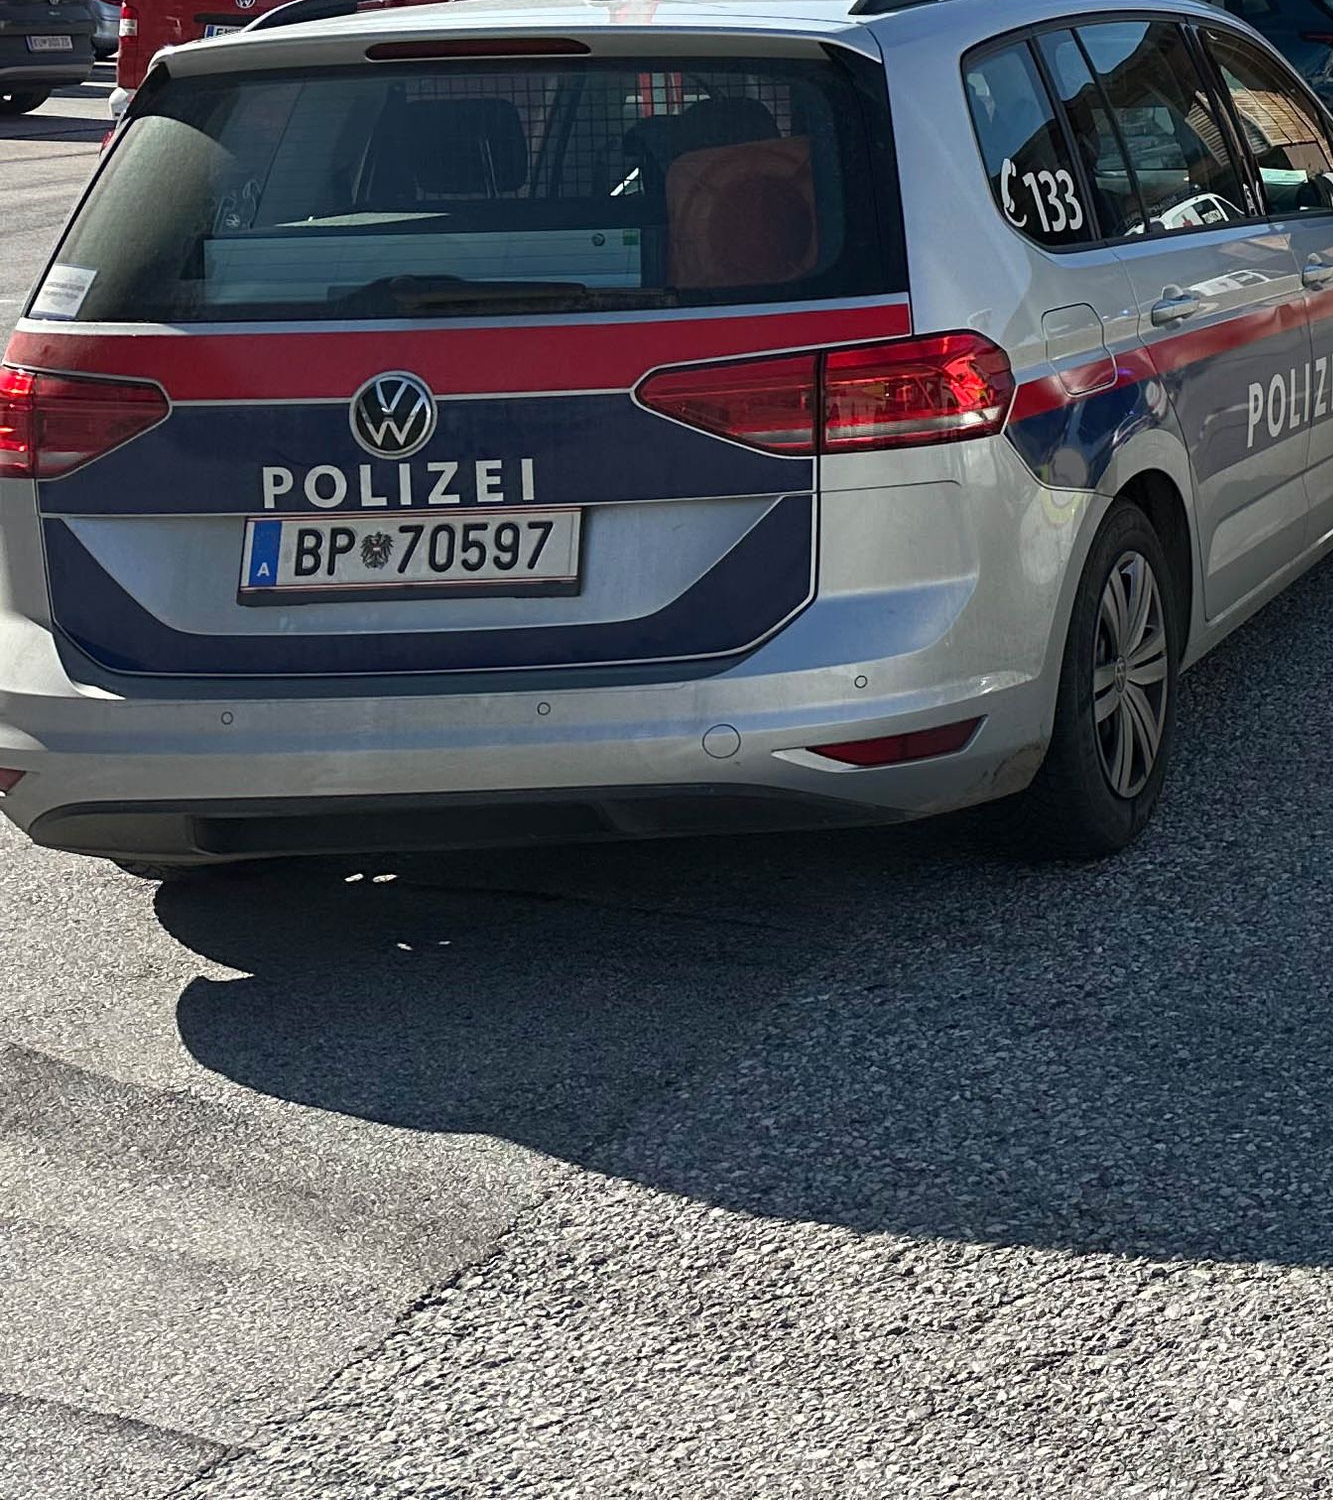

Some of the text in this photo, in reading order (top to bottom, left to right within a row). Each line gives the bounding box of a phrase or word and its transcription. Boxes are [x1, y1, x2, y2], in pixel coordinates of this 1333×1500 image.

[1022, 168, 1084, 233] 133
[262, 457, 535, 509] POLIZEI
[256, 561, 270, 577] A
[294, 520, 555, 577] BP 70597
